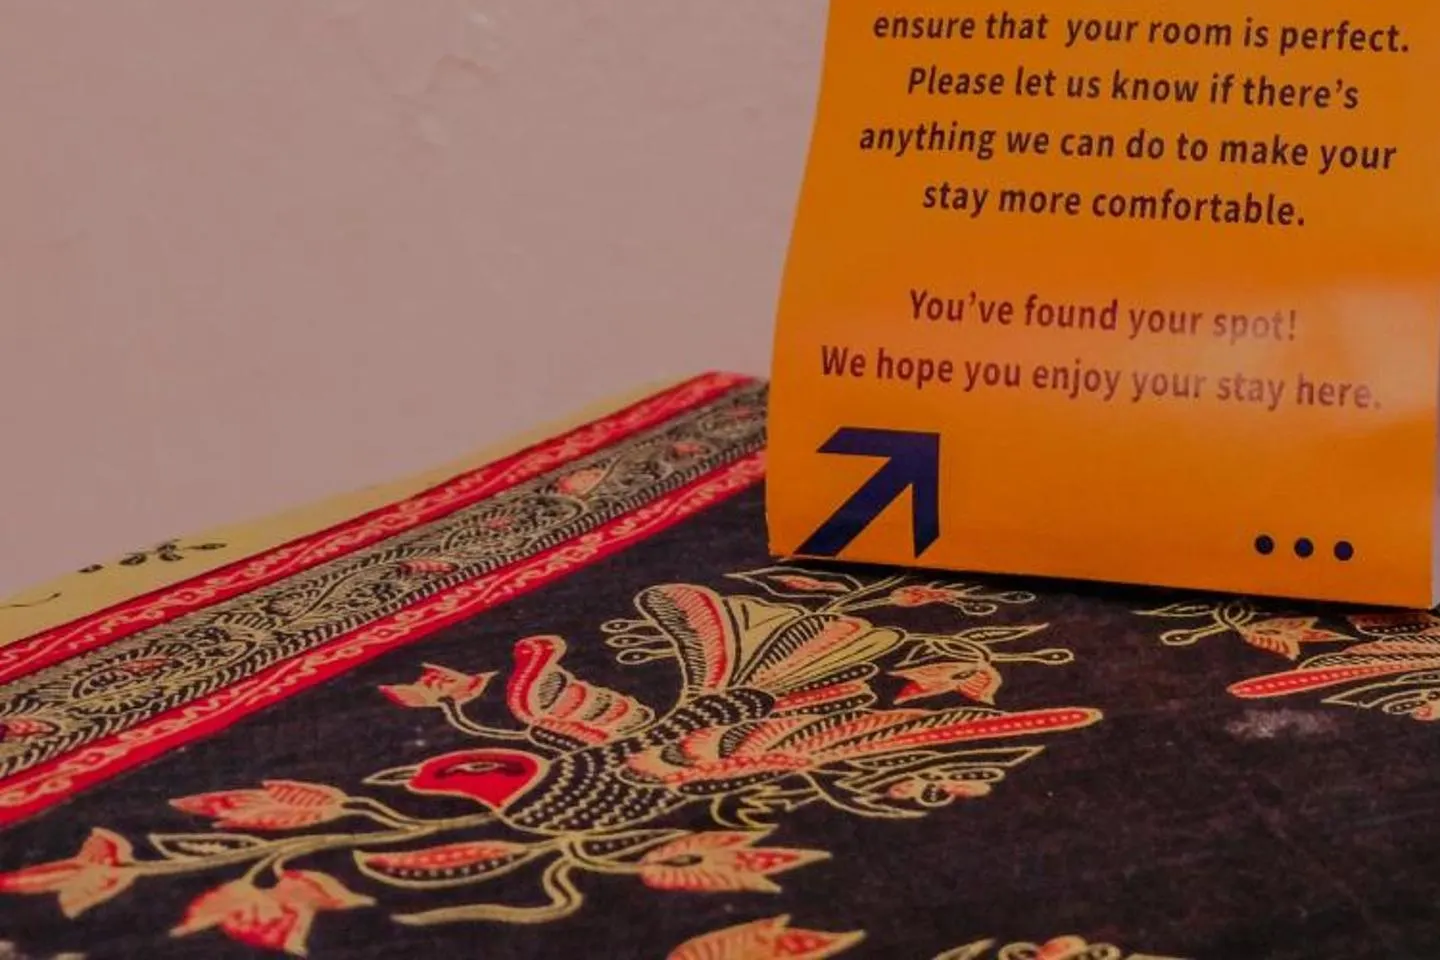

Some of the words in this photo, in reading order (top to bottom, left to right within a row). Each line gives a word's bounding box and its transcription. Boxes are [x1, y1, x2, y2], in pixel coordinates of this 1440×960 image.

[872, 15, 979, 40] ensure
[983, 10, 1051, 44] that
[1064, 17, 1141, 49] your
[1147, 20, 1233, 47] room
[1242, 16, 1270, 50] is
[1276, 19, 1409, 57] perfect.
[907, 64, 1008, 98] Please
[1014, 65, 1057, 98] let
[1065, 75, 1102, 100] us
[1111, 68, 1200, 103] know
[1209, 72, 1238, 105] if
[859, 120, 997, 163] anything
[1003, 130, 1052, 157] we
[1058, 131, 1115, 159] can
[1125, 128, 1167, 161] do
[1176, 132, 1209, 162] to
[1217, 133, 1308, 169] make
[1317, 144, 1399, 176] your
[922, 180, 992, 219] stay
[998, 188, 1082, 216] more
[1091, 187, 1304, 227] comfortable.
[1024, 293, 1118, 331] found
[1128, 308, 1203, 340] your
[1213, 310, 1296, 344] spot!
[820, 345, 866, 378] We
[876, 347, 954, 390] hope
[963, 361, 1021, 392] you
[1032, 357, 1121, 399] enjoy
[1131, 371, 1207, 403] your
[1216, 373, 1285, 412] stay
[1296, 373, 1380, 409] here.
